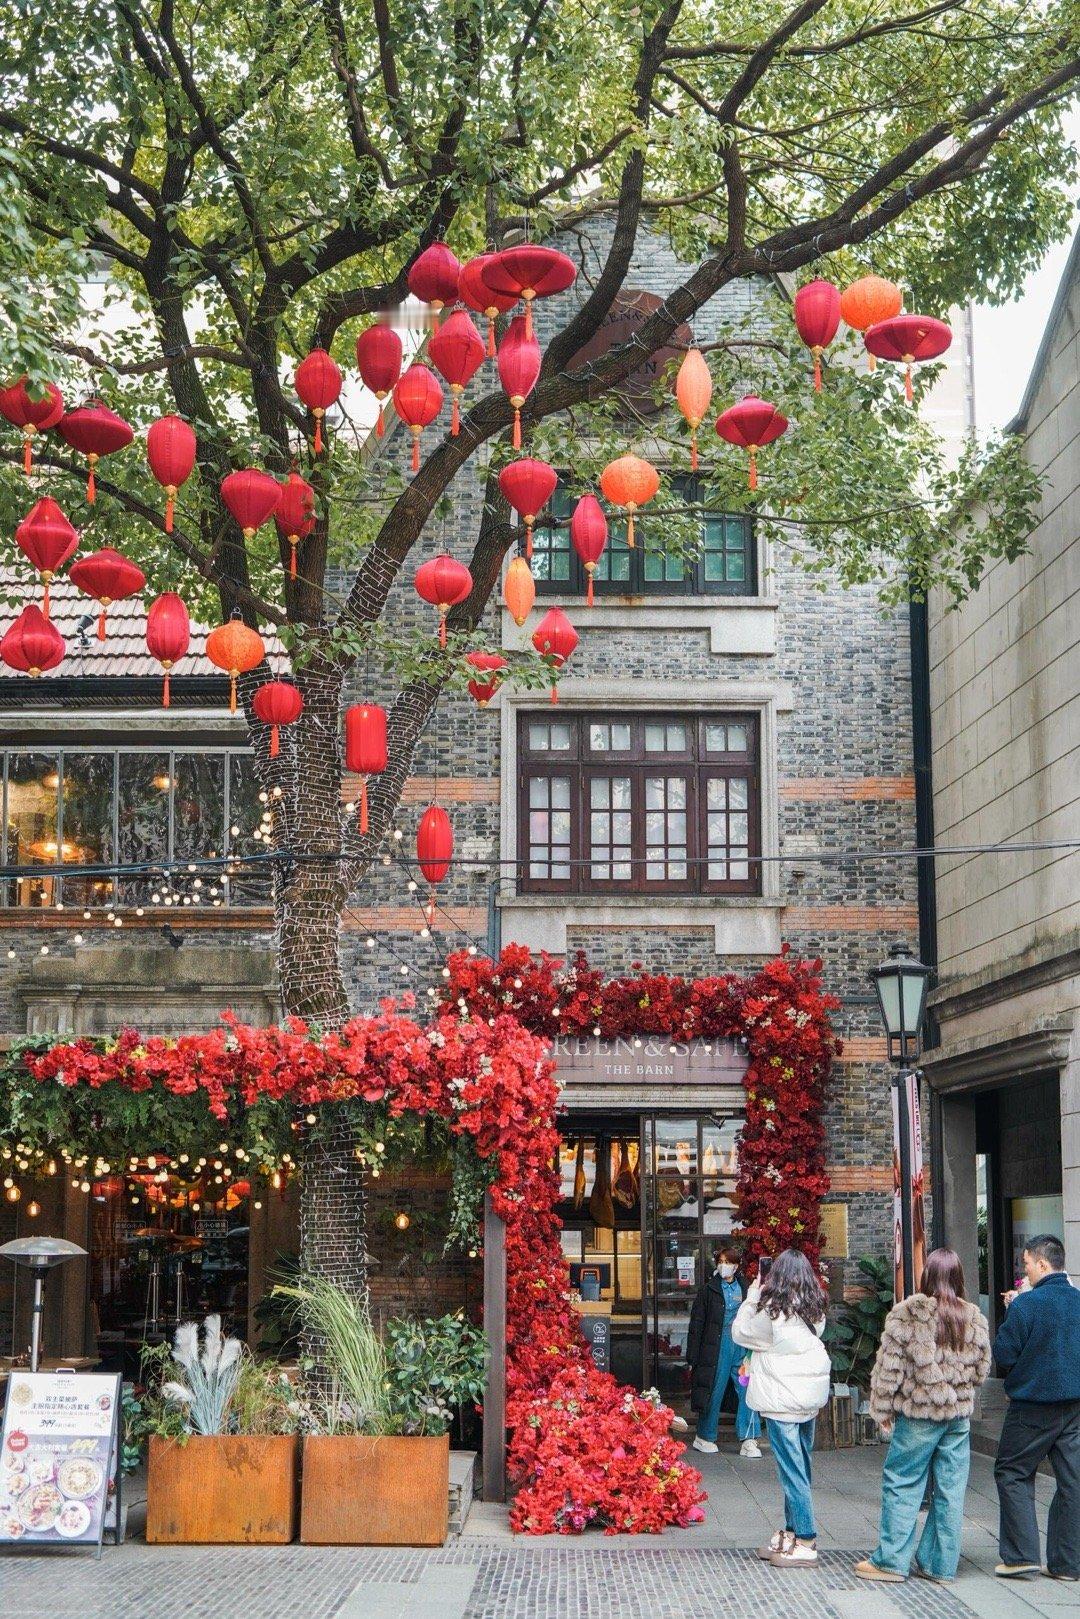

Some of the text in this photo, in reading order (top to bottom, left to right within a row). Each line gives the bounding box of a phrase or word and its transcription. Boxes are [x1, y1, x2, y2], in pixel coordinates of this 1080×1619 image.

[551, 1035, 749, 1057] REEN & SAFE
[605, 1064, 674, 1075] THE BARN
